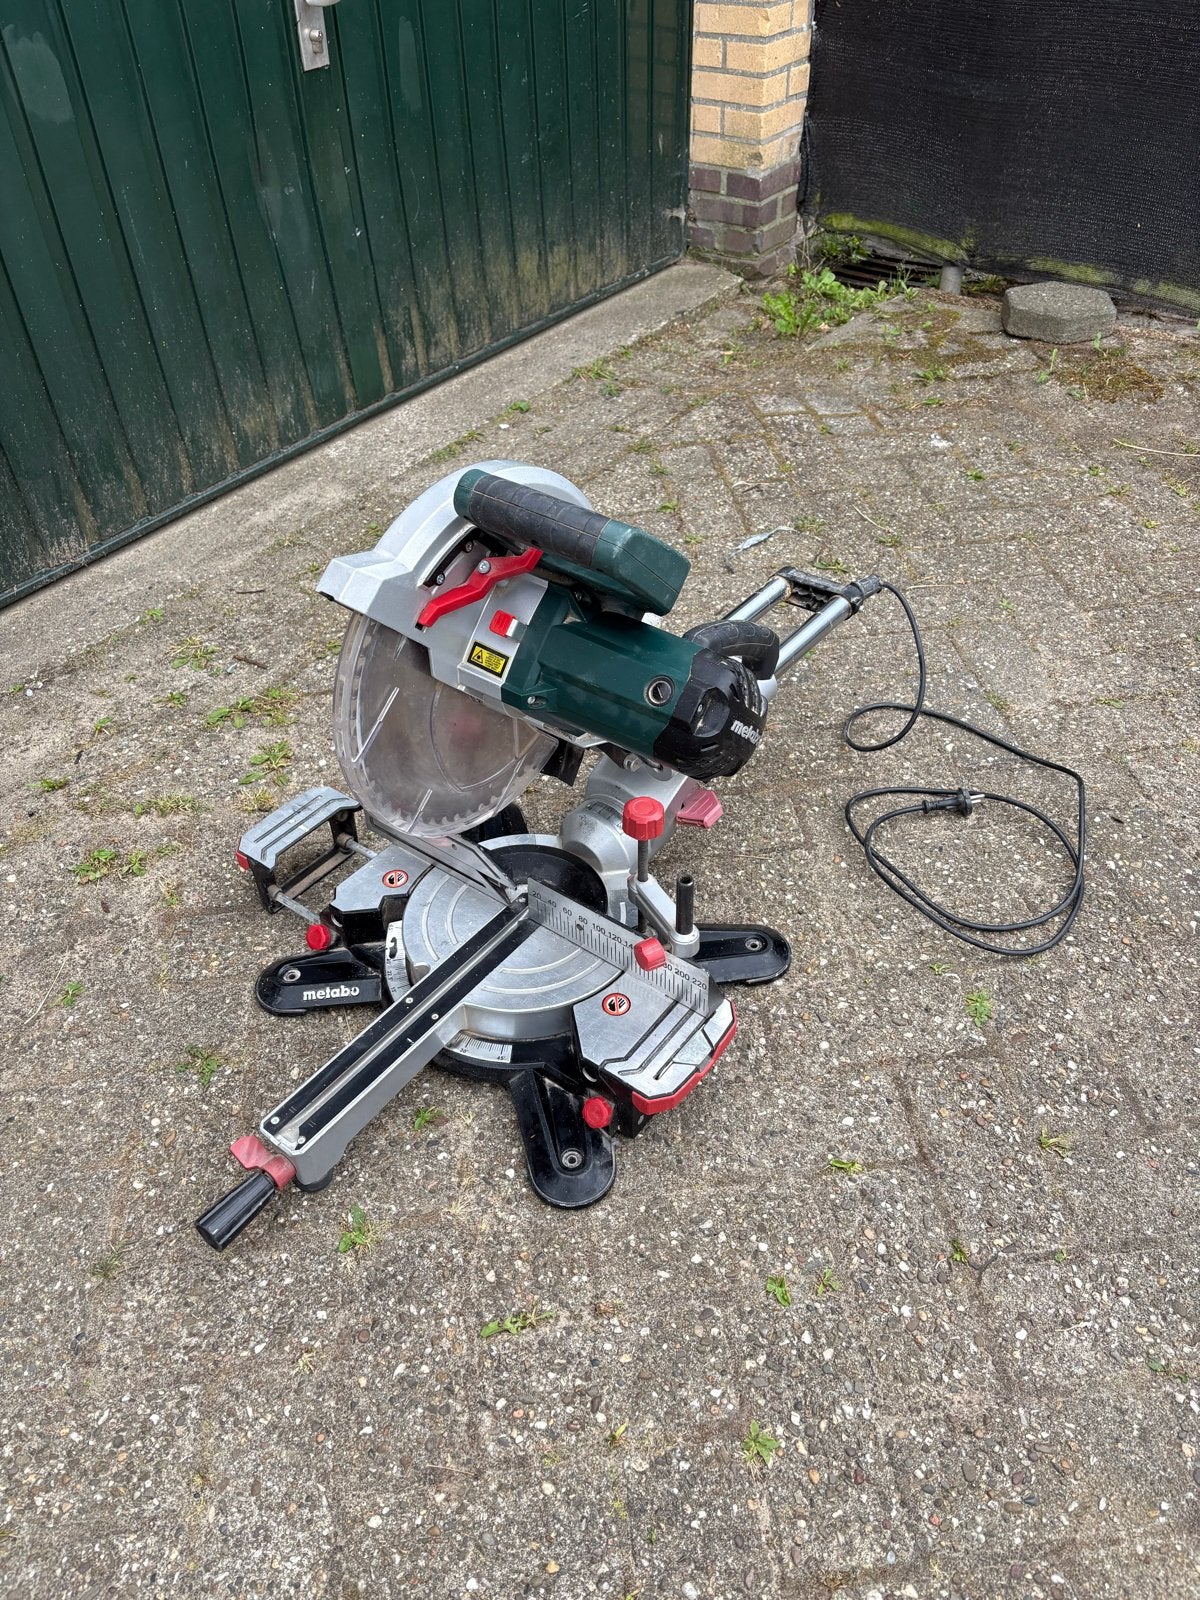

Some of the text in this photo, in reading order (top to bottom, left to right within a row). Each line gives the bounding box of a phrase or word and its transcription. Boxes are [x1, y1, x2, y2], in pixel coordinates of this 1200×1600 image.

[548, 900, 557, 908] 40
[562, 907, 573, 916] 60
[578, 915, 588, 925] 80
[592, 923, 606, 936] 100
[608, 931, 622, 944] 120
[674, 968, 690, 981] 200
[692, 977, 707, 991] 220
[303, 984, 360, 1001] metabo
